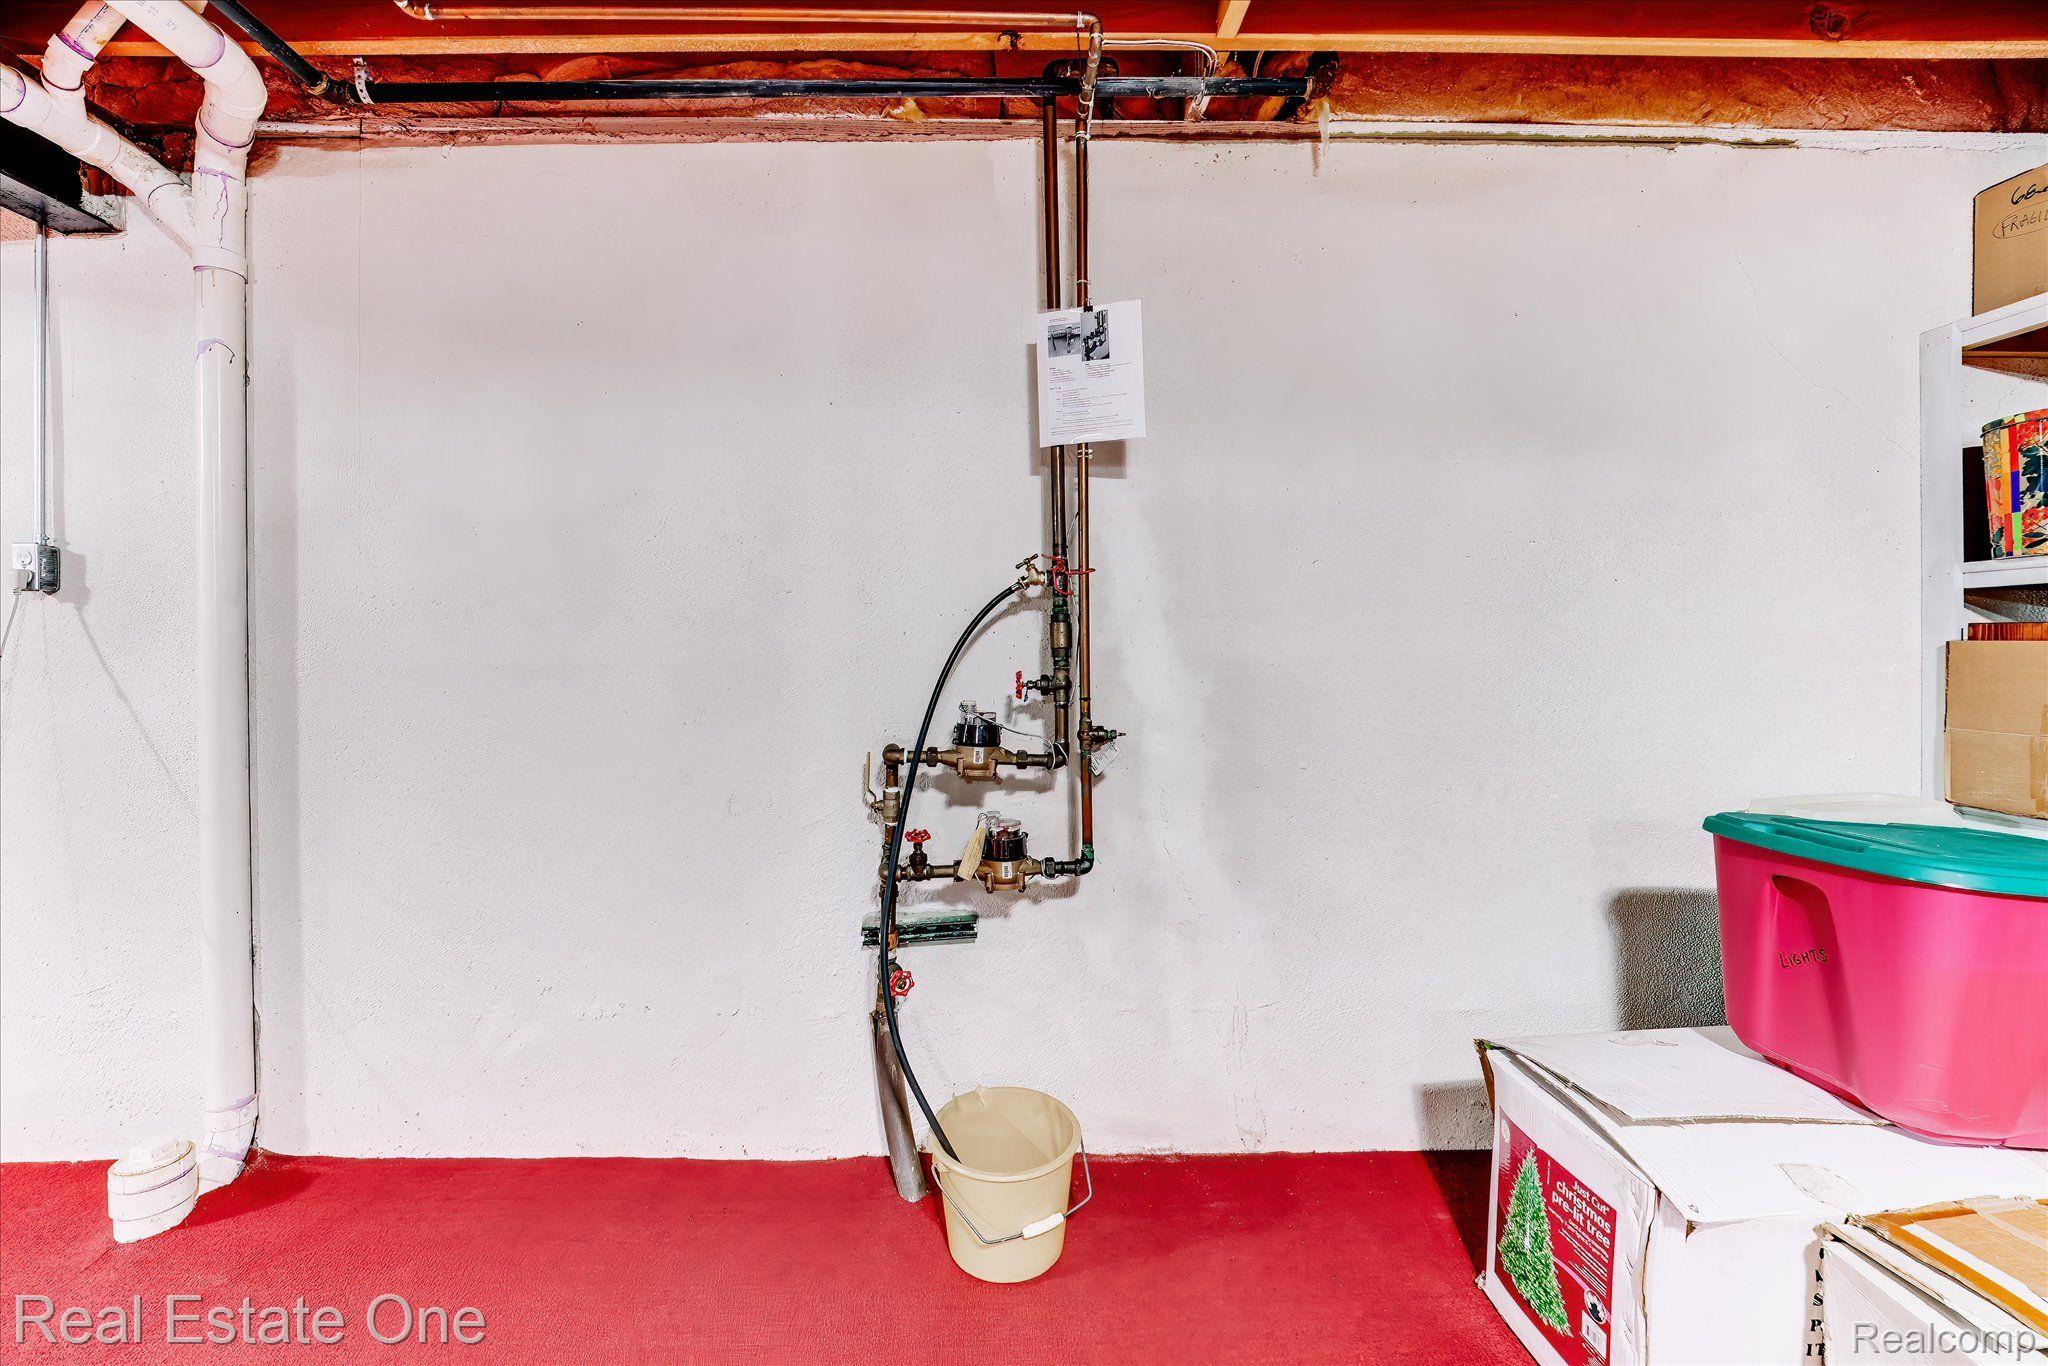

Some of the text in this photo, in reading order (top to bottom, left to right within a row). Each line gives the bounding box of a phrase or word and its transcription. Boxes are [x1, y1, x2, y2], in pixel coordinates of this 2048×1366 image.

[1777, 948, 1828, 969] LIGHTS
[1556, 1181, 1611, 1234] christmas
[1572, 1181, 1591, 1202] Just
[1552, 1190, 1585, 1227] pre-lit
[1586, 1219, 1611, 1249] tree
